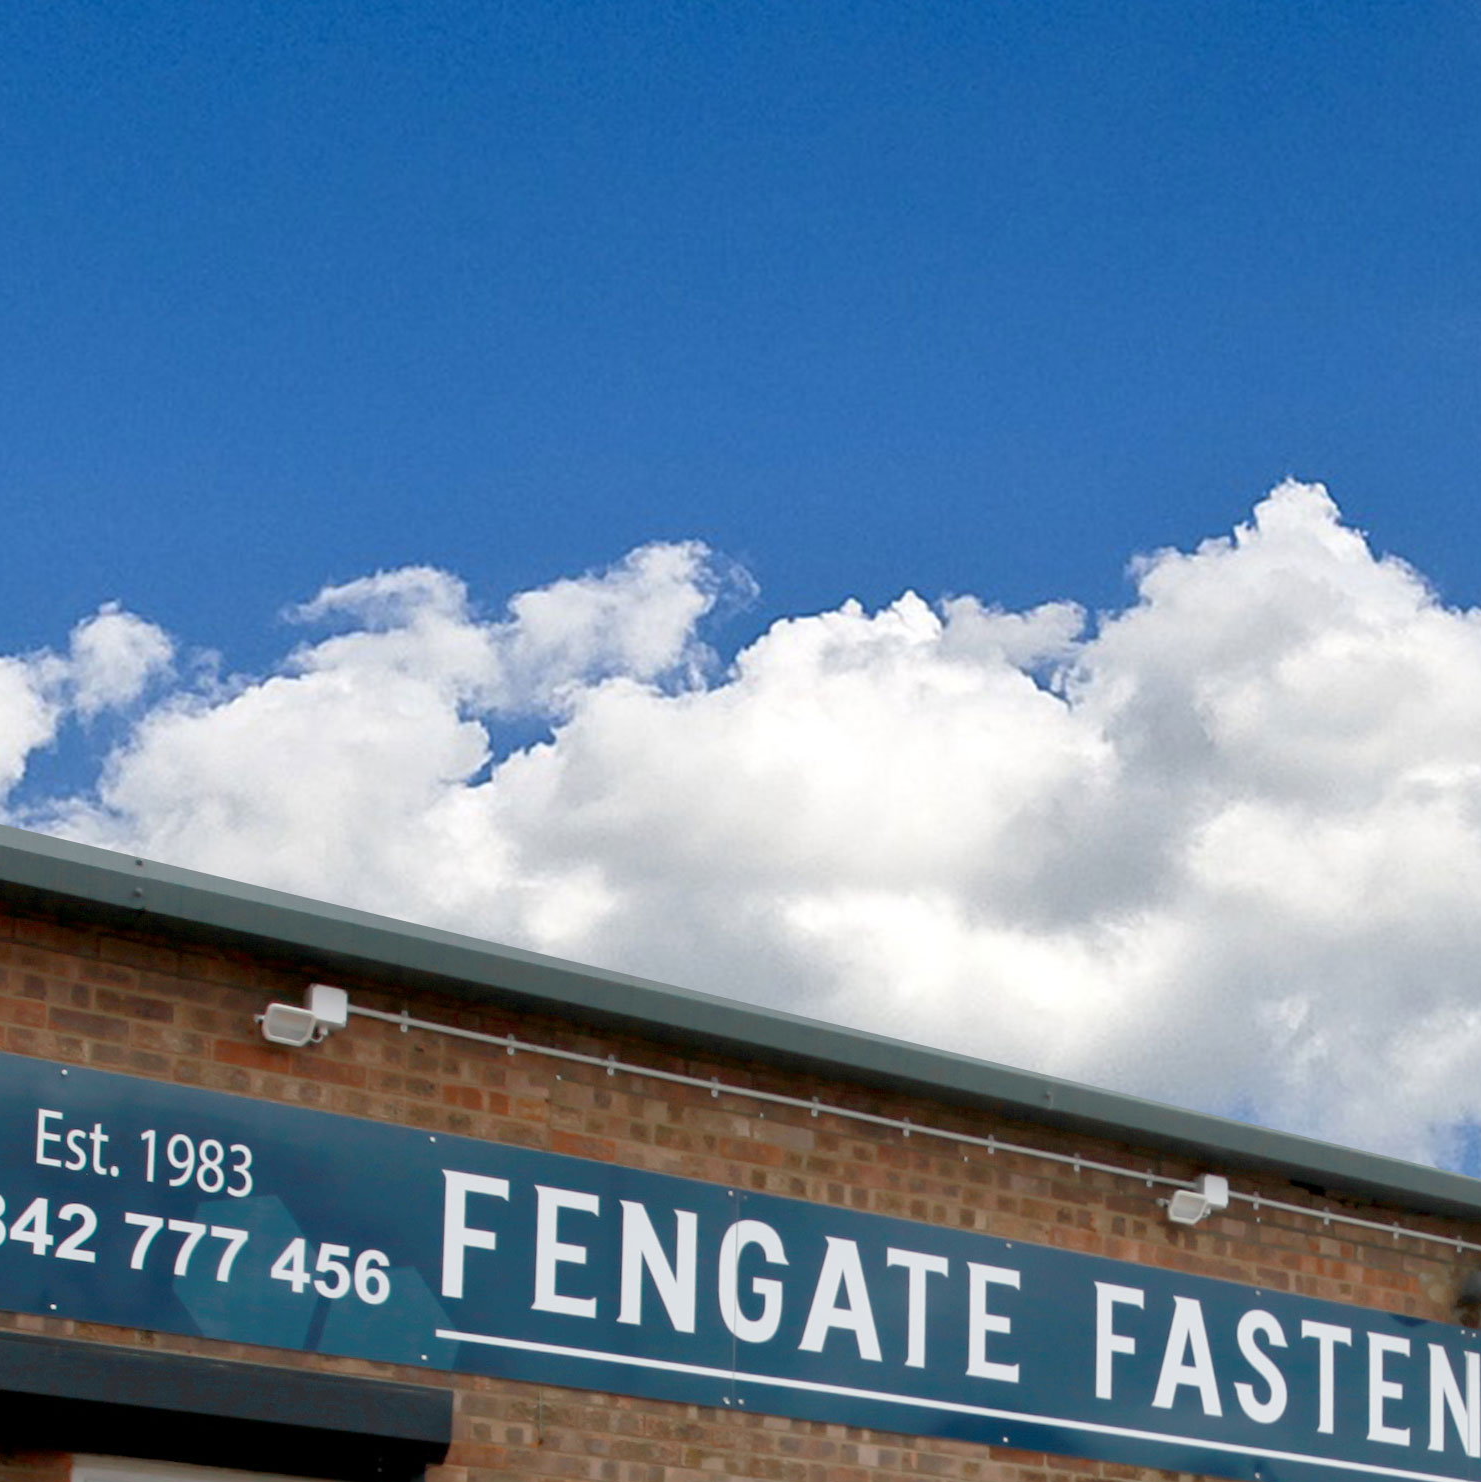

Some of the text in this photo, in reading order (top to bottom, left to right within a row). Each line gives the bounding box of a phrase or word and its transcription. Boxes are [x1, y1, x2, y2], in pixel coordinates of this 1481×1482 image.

[36, 1109, 255, 1198] Est. 1983
[123, 1211, 250, 1283] 777
[270, 1238, 391, 1305] 456
[440, 1168, 1022, 1385] FENGATE
